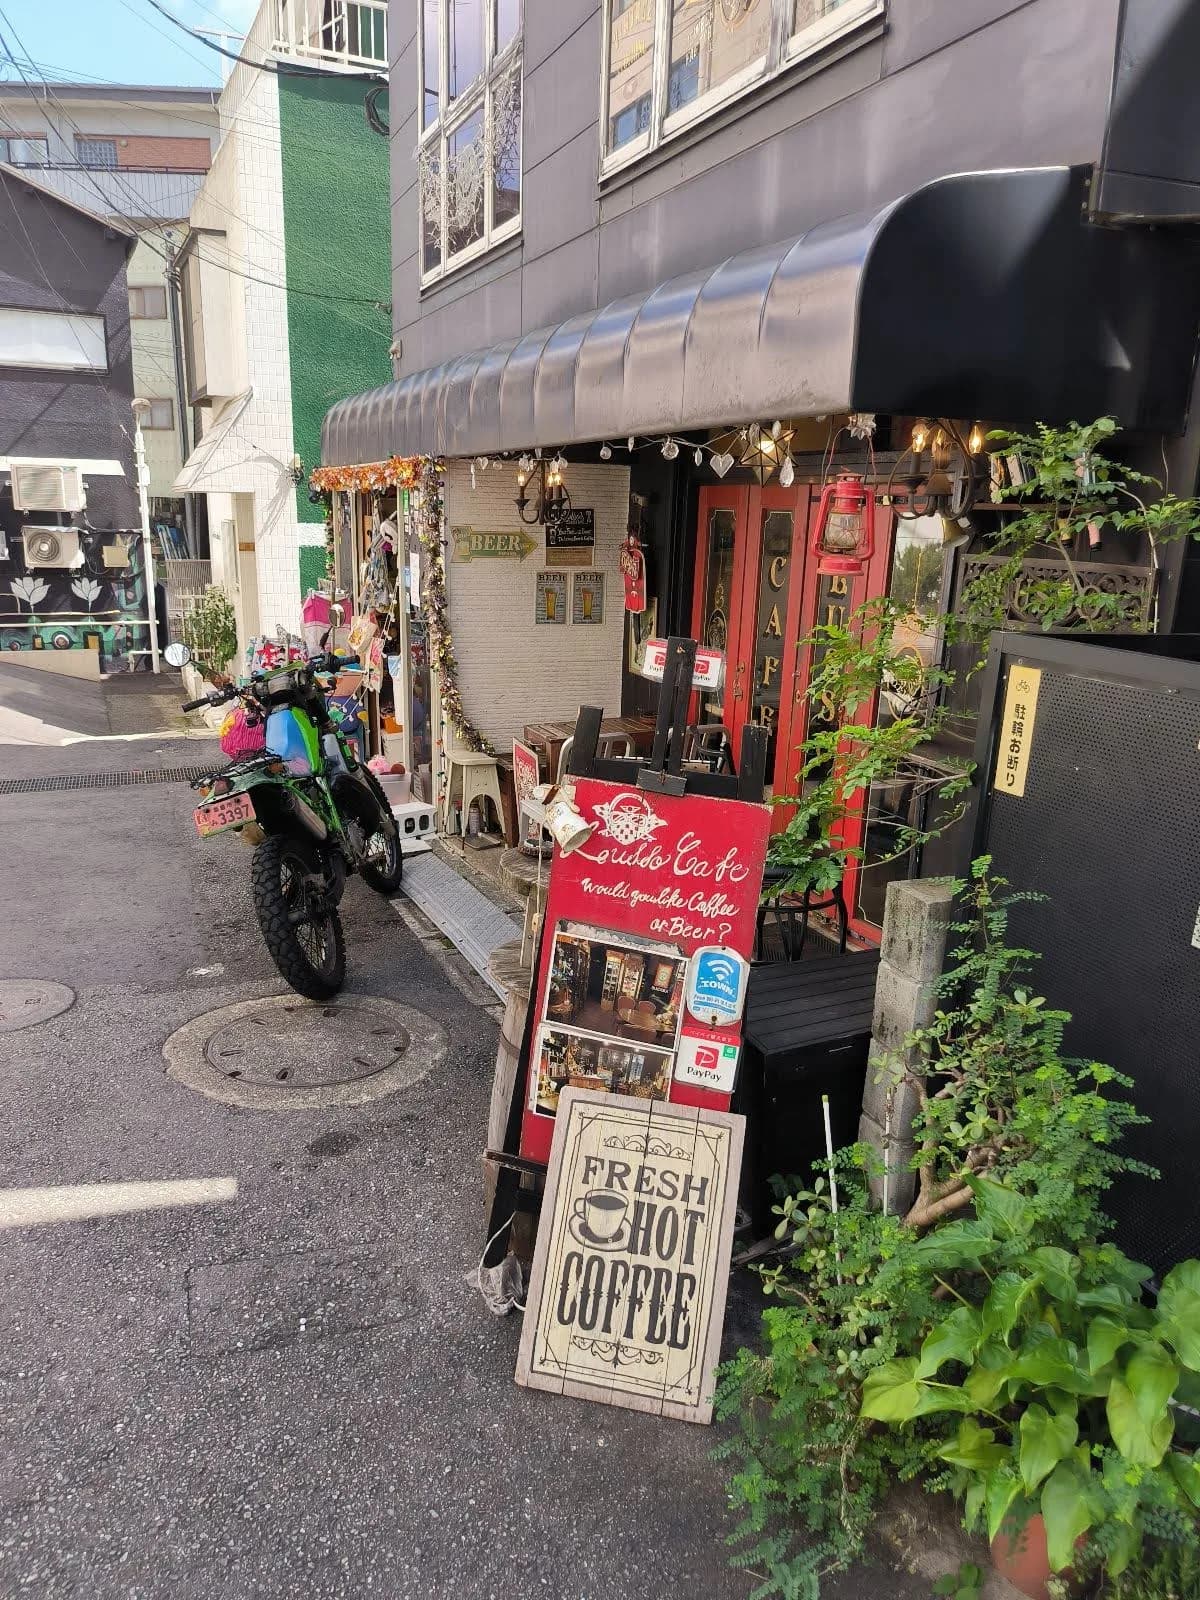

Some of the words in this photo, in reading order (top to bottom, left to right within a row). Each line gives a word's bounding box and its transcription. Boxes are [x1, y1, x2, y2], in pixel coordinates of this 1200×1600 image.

[470, 534, 522, 551] BEER
[538, 574, 567, 582] BEER
[575, 574, 603, 582] BEER
[1006, 703, 1027, 787] 駐輪お断り
[218, 803, 250, 826] 3397
[673, 831, 750, 882] Cafe
[687, 891, 741, 919] Coffee
[686, 1066, 722, 1082] PayPay
[581, 1155, 710, 1206] FRESH
[626, 1199, 706, 1267] HOT
[556, 1250, 698, 1352] COFFEE
